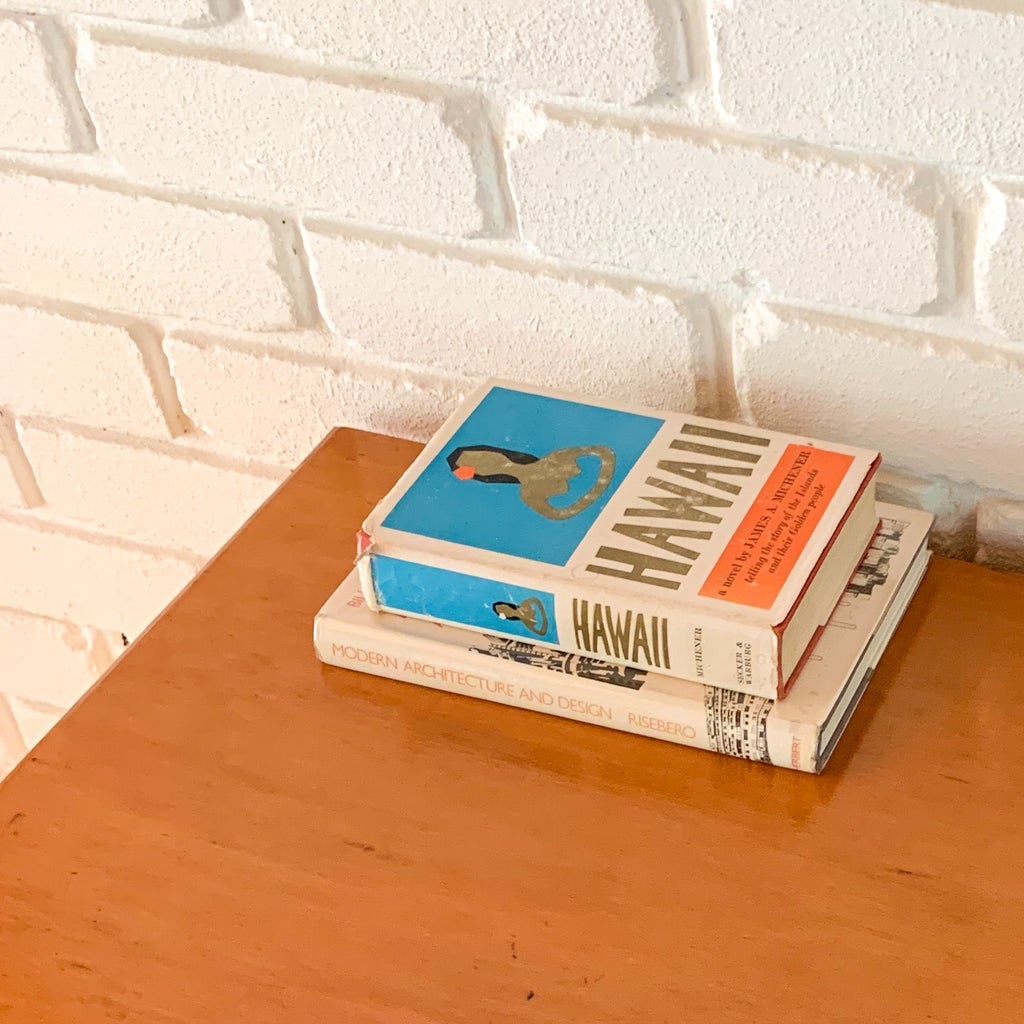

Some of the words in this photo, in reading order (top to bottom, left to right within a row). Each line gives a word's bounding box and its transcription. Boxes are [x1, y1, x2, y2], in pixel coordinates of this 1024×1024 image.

[585, 423, 771, 590] HAWAII
[723, 563, 743, 588] novel
[736, 550, 752, 562] by
[744, 515, 772, 549] JAMES
[772, 450, 811, 503] MICHENER
[744, 556, 765, 583] telling
[761, 541, 775, 556] the
[772, 520, 789, 540] story
[783, 510, 793, 521] of
[788, 498, 801, 511] the
[796, 469, 819, 497] Islands
[768, 556, 782, 574] and
[777, 537, 794, 557] their
[789, 509, 810, 535] Golden
[808, 484, 825, 509] people
[572, 598, 671, 669] HAWAII
[695, 627, 704, 677] MICHENER
[736, 652, 744, 685] SECKER
[744, 643, 752, 685] WARBURG
[332, 643, 398, 670] MODERN
[403, 661, 515, 697] ARCHITECTURE
[519, 688, 553, 706] AND
[558, 696, 612, 720] DESIGN
[628, 713, 696, 739] RISEBERO
[792, 736, 800, 770] ERBERT
